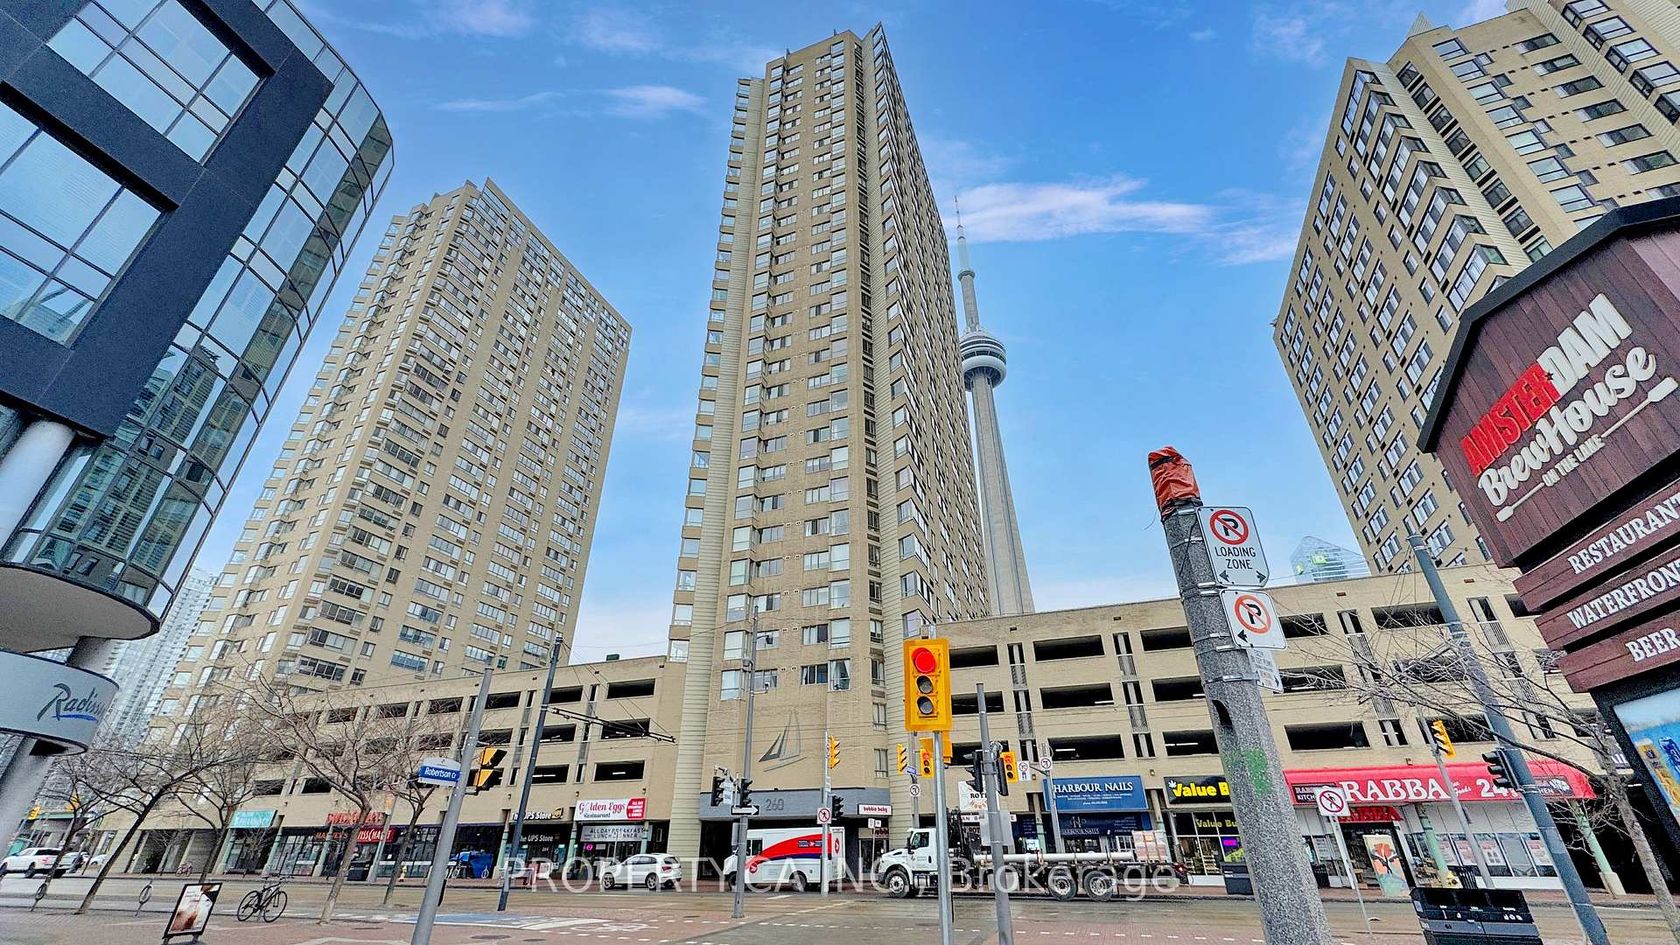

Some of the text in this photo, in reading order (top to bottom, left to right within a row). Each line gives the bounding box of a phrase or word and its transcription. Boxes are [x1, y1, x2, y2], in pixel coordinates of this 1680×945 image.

[1477, 347, 1656, 507] BrewHouse
[1541, 434, 1606, 487] ON THE LAKE
[1214, 546, 1257, 558] LOADING
[1225, 559, 1253, 570] ZONE
[1567, 558, 1680, 629] WATERFRON
[1625, 627, 1680, 662] BEER
[424, 767, 451, 778] Robertson
[1054, 781, 1134, 793] HARBOUR NAILS
[1172, 781, 1231, 797] Value B
[1339, 778, 1451, 801] RABBA
[608, 800, 626, 815] Eggs
[765, 798, 785, 811] 260
[535, 810, 552, 820] Store
[1196, 819, 1239, 828] Value Bu
[528, 834, 539, 842] UPS
